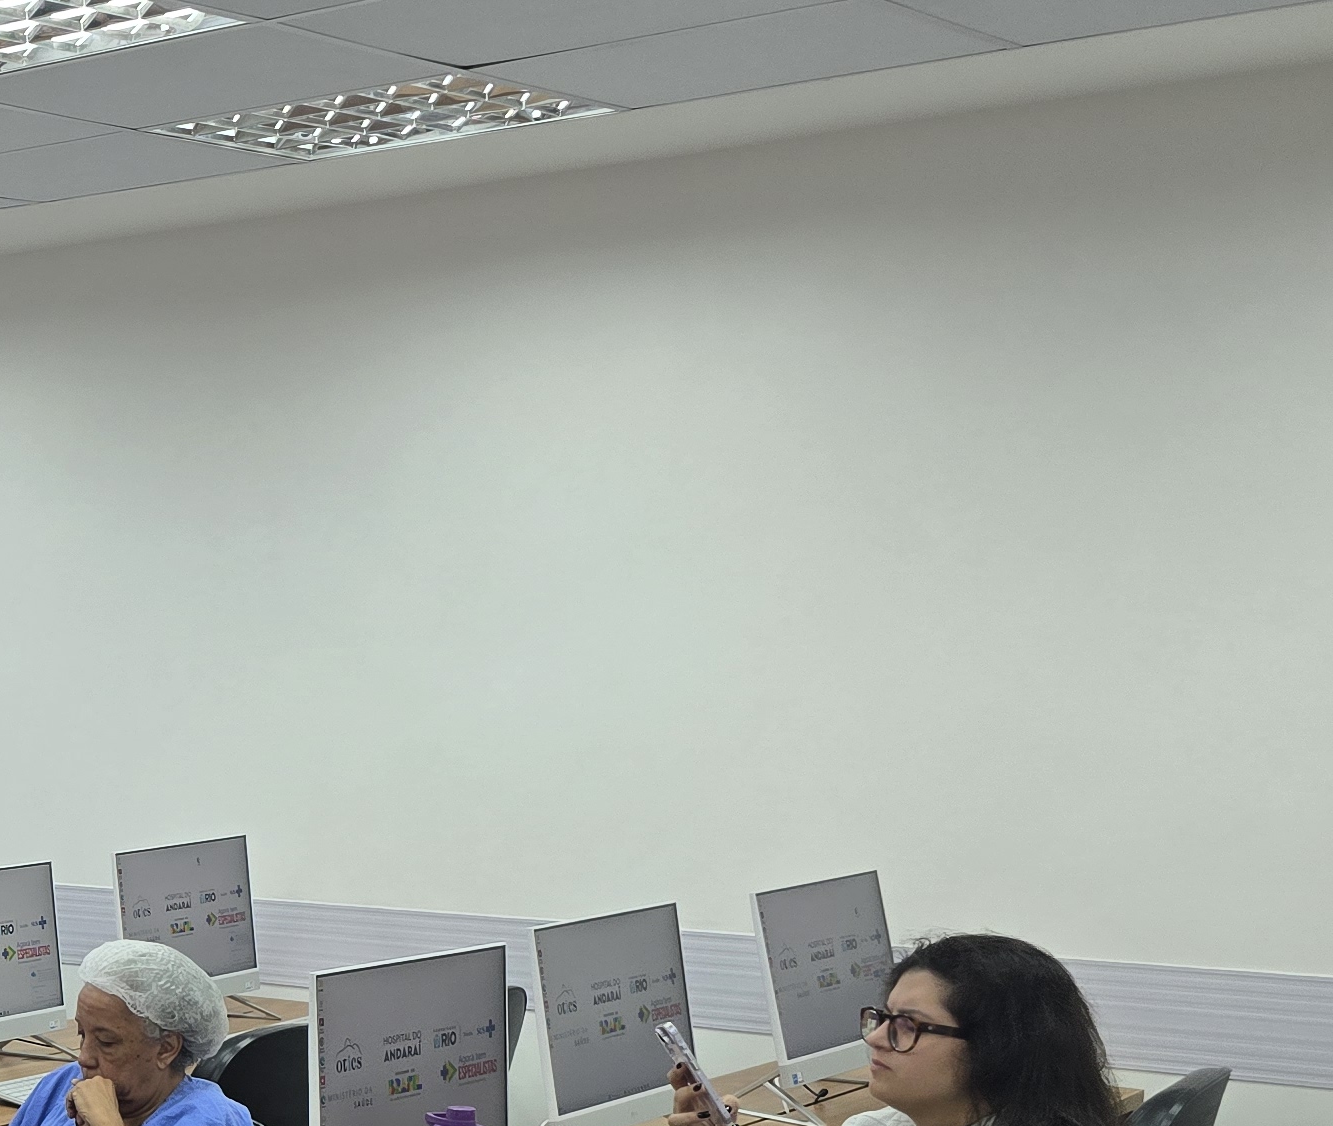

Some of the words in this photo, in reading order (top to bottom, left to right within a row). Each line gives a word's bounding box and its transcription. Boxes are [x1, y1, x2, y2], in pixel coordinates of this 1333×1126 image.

[1, 924, 14, 935] RIO
[384, 1032, 411, 1046] HOSPITAL
[441, 1031, 456, 1047] RIO
[384, 1040, 421, 1062] ANDARAÍ
[336, 1056, 362, 1073] otics
[458, 1059, 497, 1080] ESPECIALISTAS
